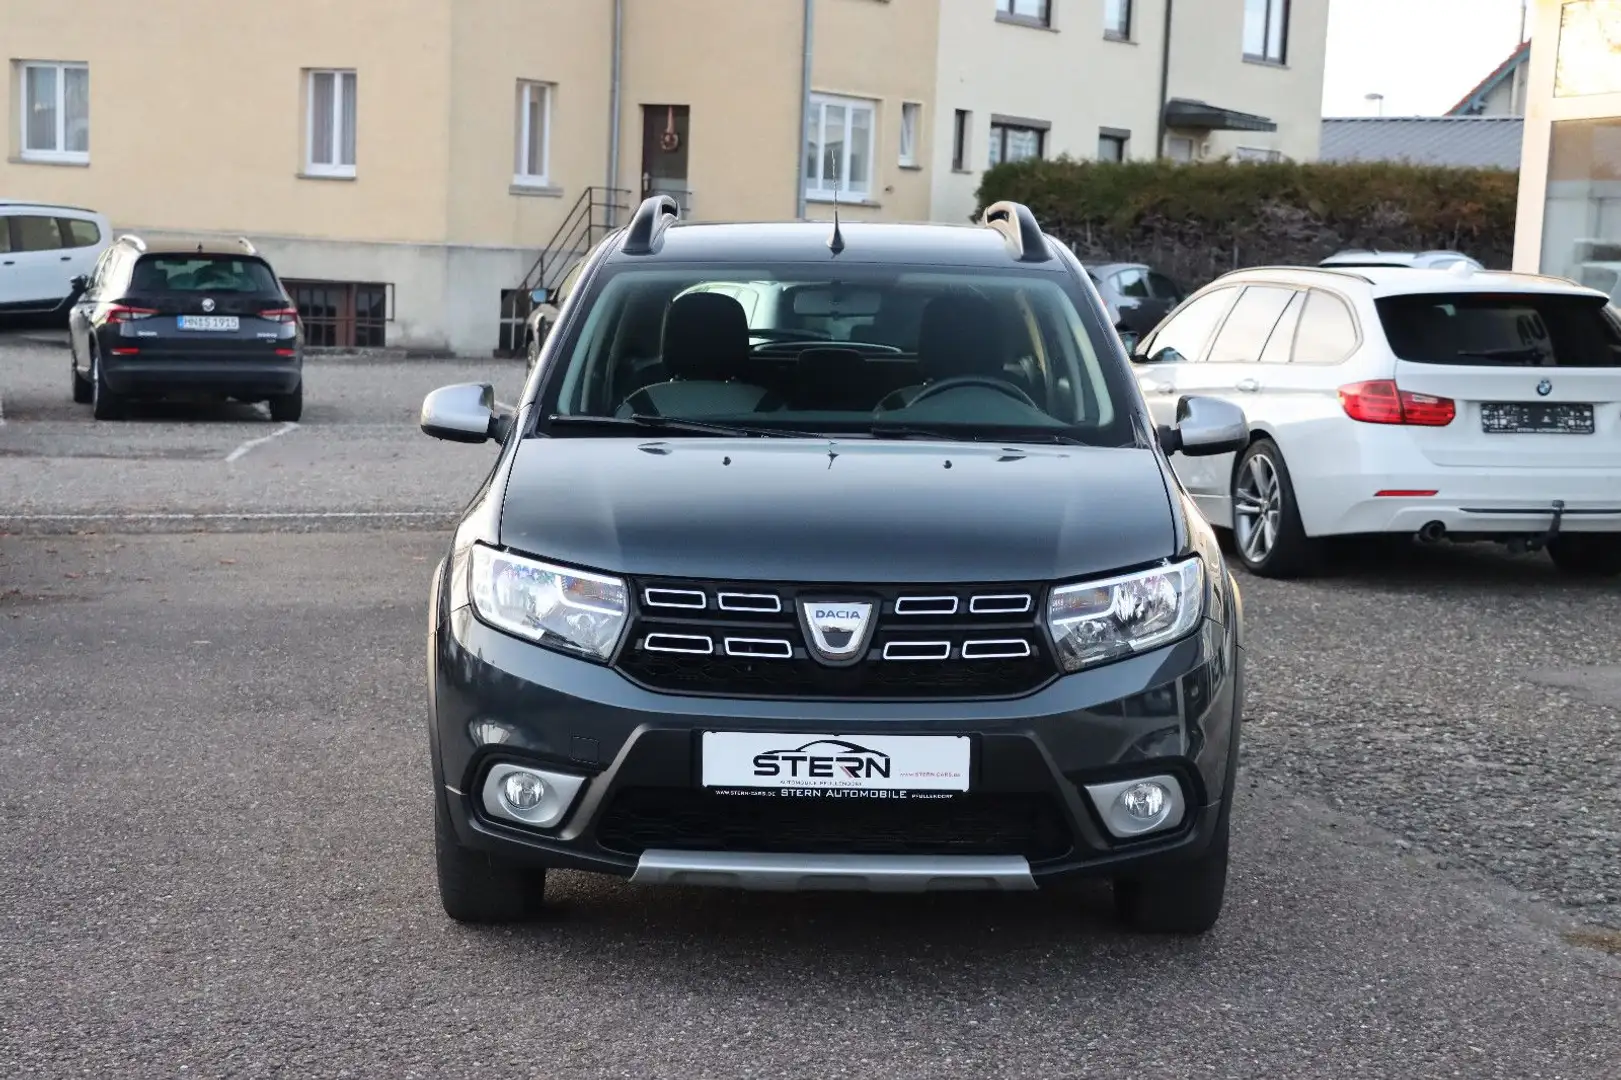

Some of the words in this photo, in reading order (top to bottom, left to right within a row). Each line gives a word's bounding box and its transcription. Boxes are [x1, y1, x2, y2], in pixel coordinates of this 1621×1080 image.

[815, 610, 861, 619] DACIA
[753, 754, 891, 779] STERN
[780, 788, 821, 798] STERN
[825, 789, 907, 799] AUTOMOBILE
